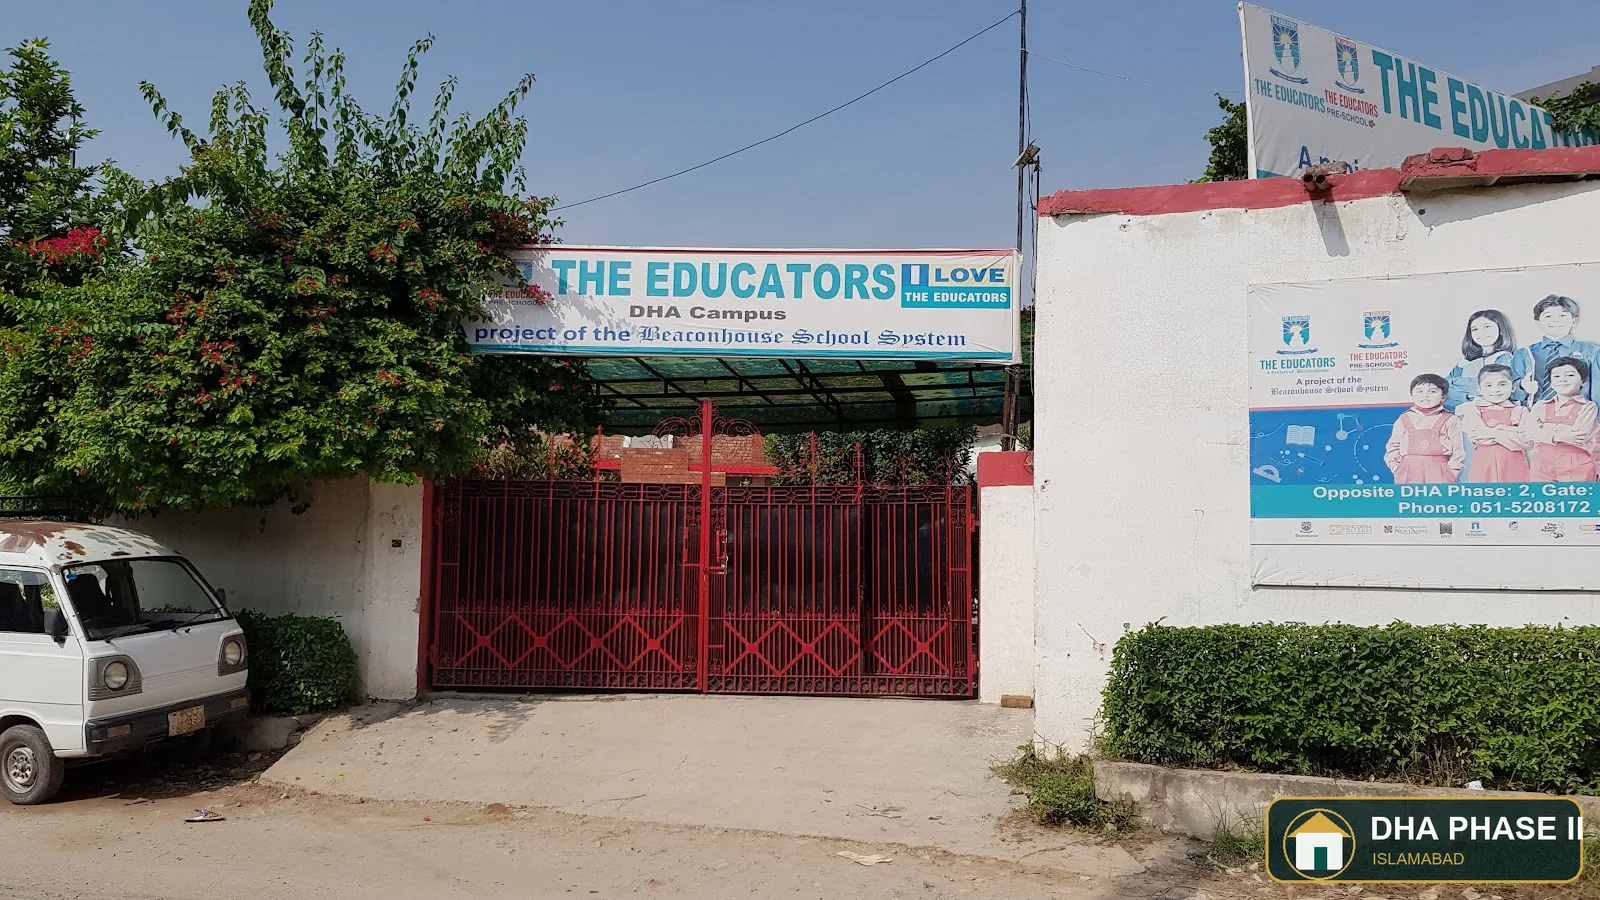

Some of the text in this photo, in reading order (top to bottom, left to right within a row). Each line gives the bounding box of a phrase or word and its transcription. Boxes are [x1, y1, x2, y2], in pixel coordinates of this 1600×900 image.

[1254, 78, 1273, 99] THE
[1274, 84, 1326, 114] EDUCATORS
[1371, 49, 1442, 130] THE
[1324, 89, 1379, 118] THE EDUCATORS
[1326, 107, 1369, 127] PRE-SCHOOL
[1298, 145, 1312, 169] A
[552, 259, 896, 300] THE EDUCATORS
[935, 267, 1005, 283] LOVE
[904, 291, 1008, 303] THE EDUCATORS
[629, 305, 787, 322] DHA Campus
[475, 325, 557, 343] project
[563, 326, 588, 341] of
[593, 326, 631, 342] the
[637, 325, 784, 346] Beaconhouse
[791, 328, 870, 347] School
[877, 329, 967, 349] System
[1259, 357, 1336, 370] THE EDUCATORS
[1349, 350, 1408, 361] THE EDUCATORS
[1349, 361, 1394, 369] PRE-SCHOOL
[1296, 376, 1362, 387] A project of the
[1270, 385, 1389, 396] Beaconhouse School System
[1312, 484, 1594, 501] Opposite DHA Phase: 2, Gate:
[1398, 501, 1465, 515] Phone:
[1469, 501, 1591, 514] 051-5208172
